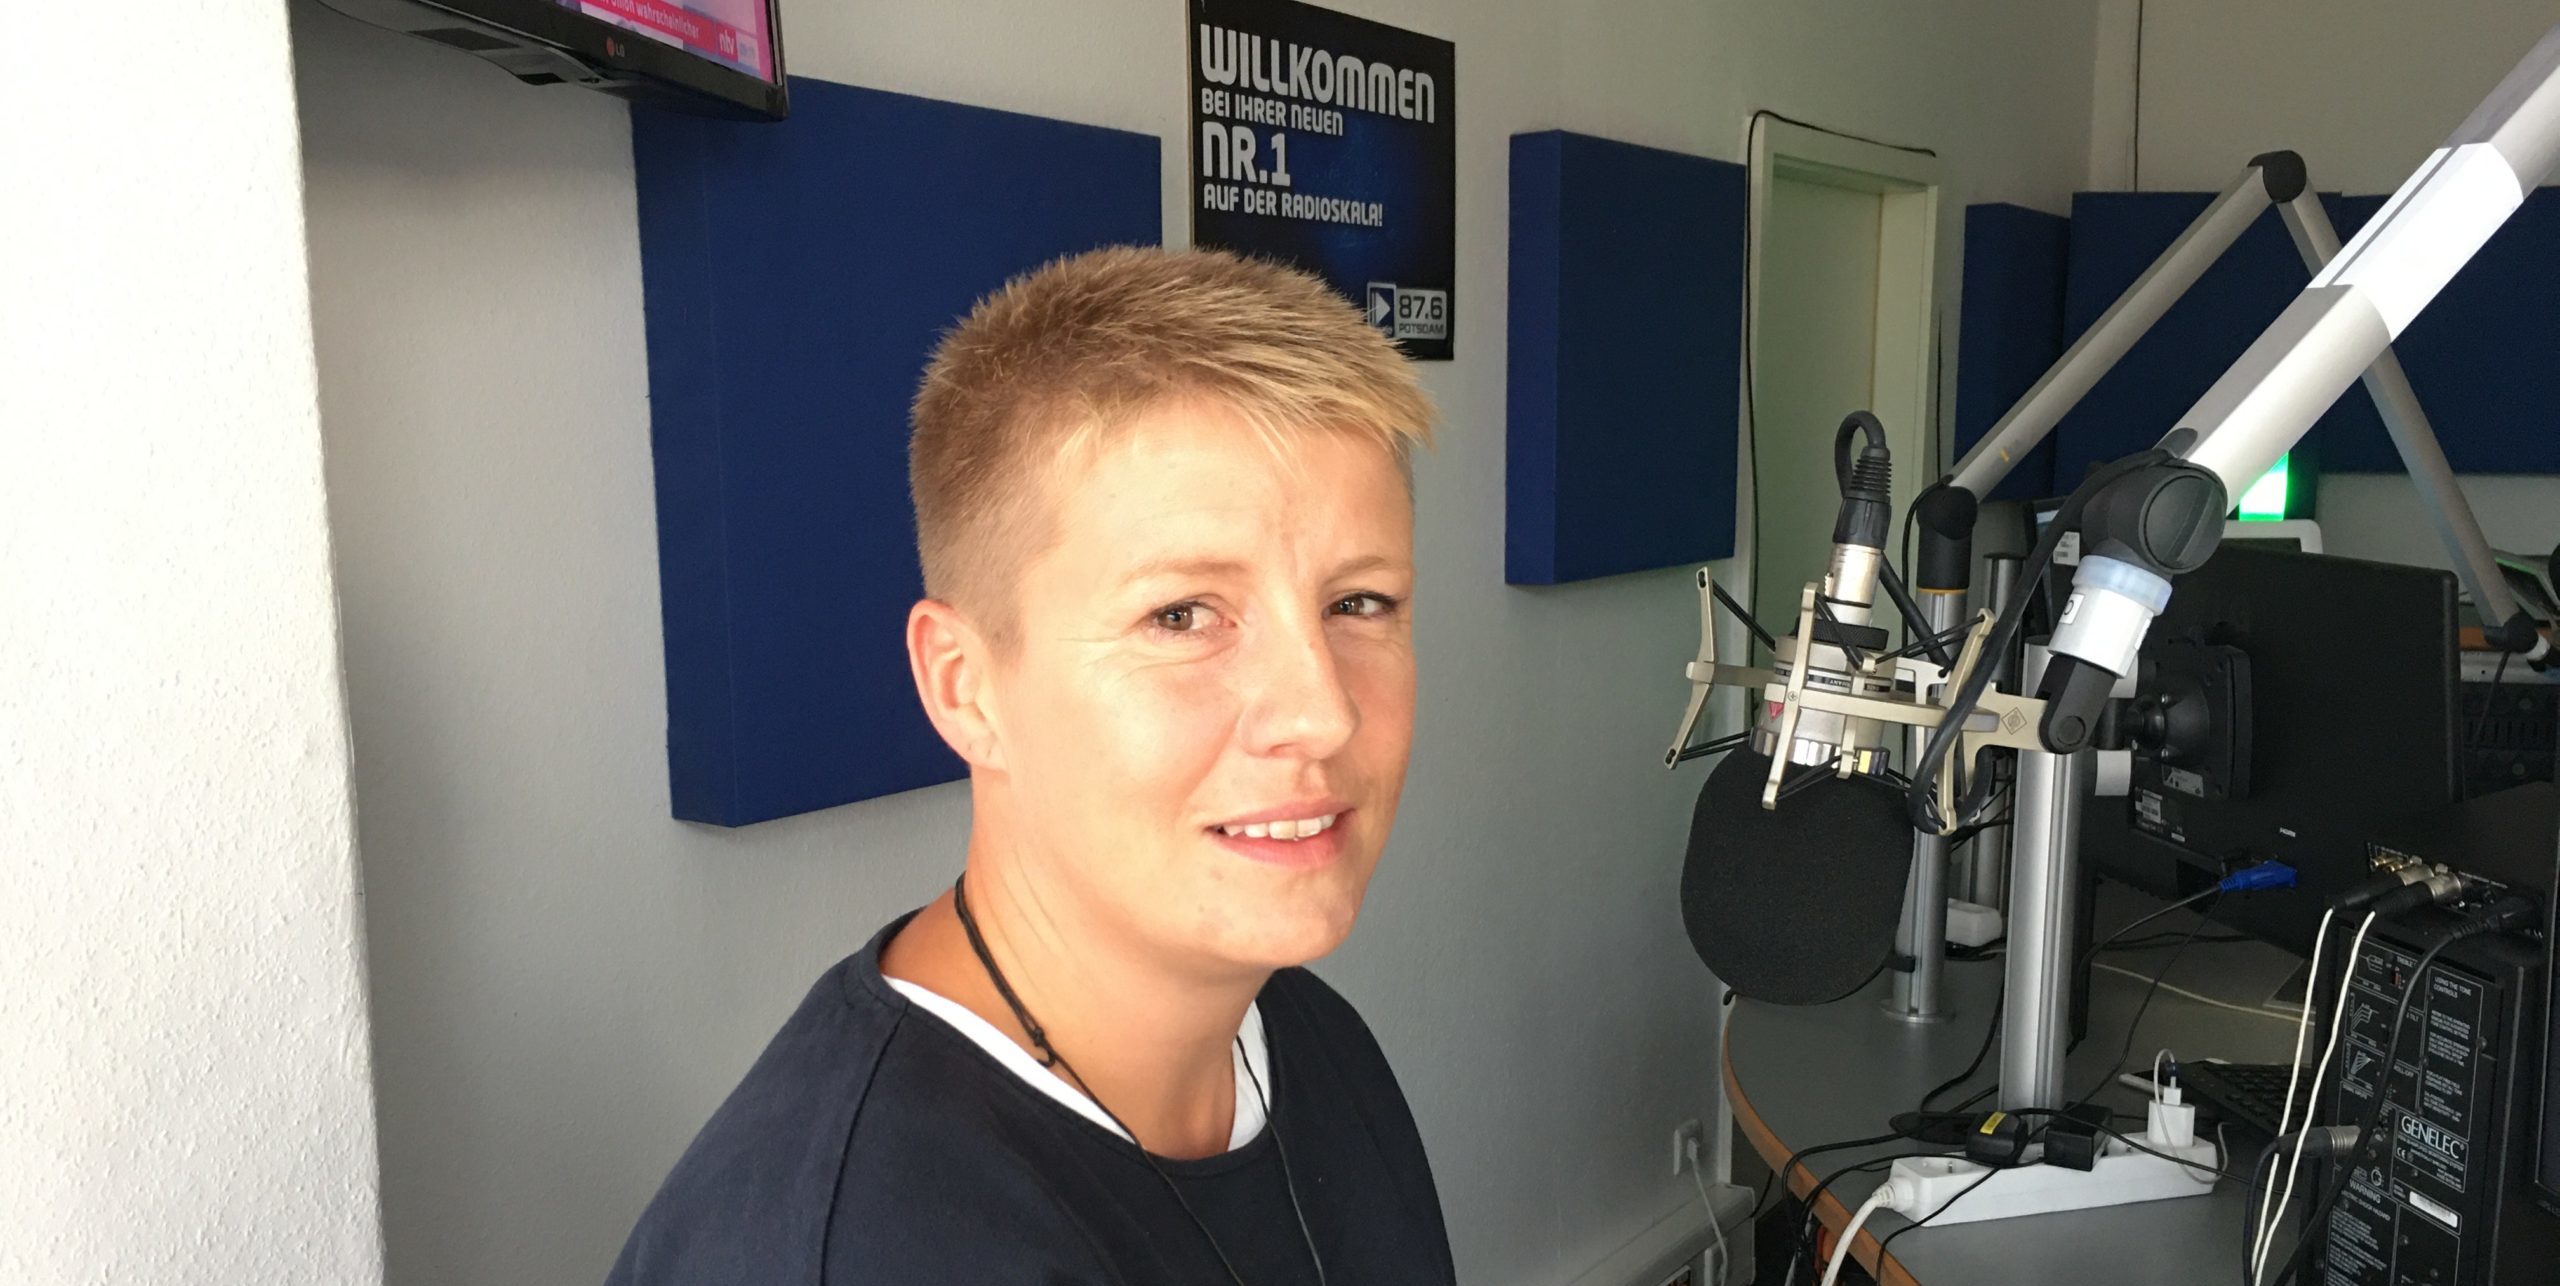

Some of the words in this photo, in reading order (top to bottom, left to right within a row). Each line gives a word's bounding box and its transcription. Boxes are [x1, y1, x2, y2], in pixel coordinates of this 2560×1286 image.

[636, 2, 700, 39] wahrscheinlicher
[615, 43, 625, 57] LG
[1200, 23, 1434, 124] WILLKOMMEN
[1201, 88, 1230, 116] BEI
[1235, 93, 1286, 127] IHRER
[1290, 104, 1343, 136] NEUEN
[1202, 121, 1291, 187] NR.1
[1203, 183, 1239, 212] AUF
[1243, 188, 1277, 216] DER
[1281, 193, 1383, 227] RADIOSKALA!
[1399, 295, 1443, 319] 87.6
[1399, 323, 1444, 334] POTSDAM
[2401, 1116, 2461, 1159] GENELEC
[2349, 1179, 2380, 1203] WARNING
